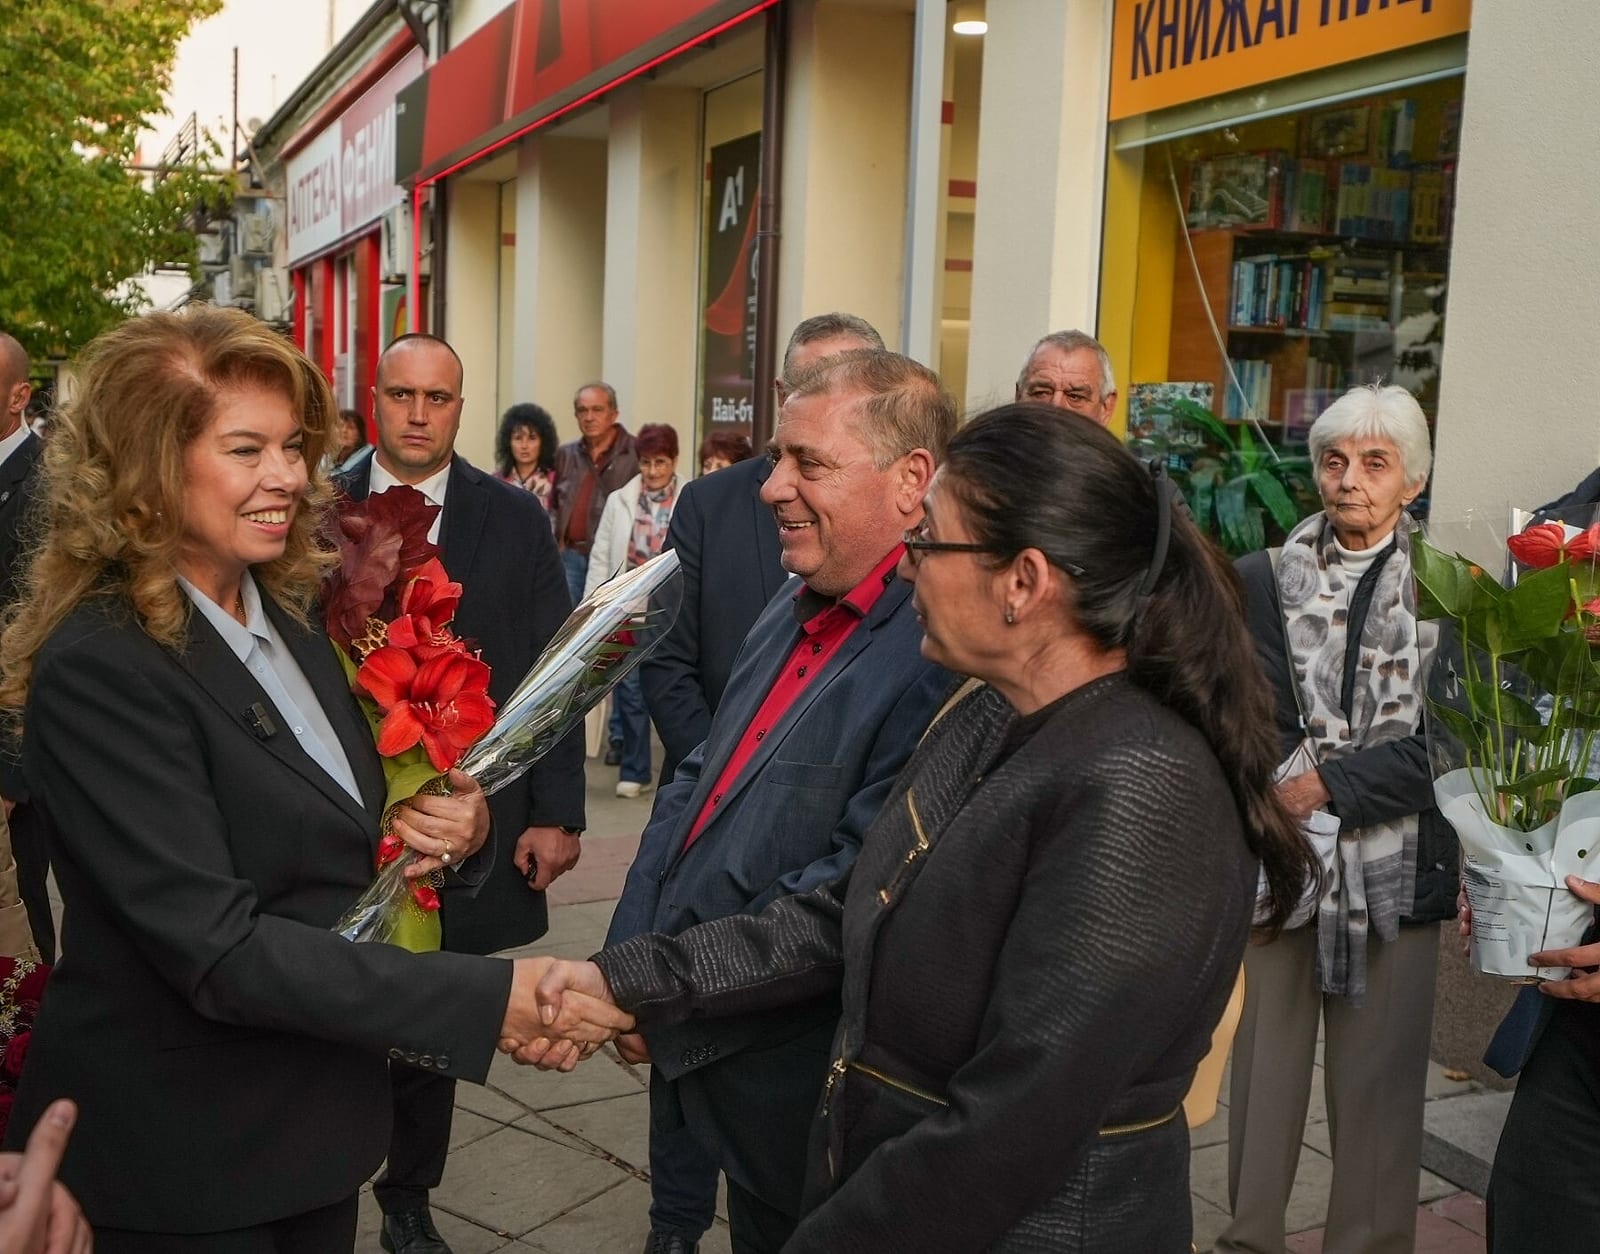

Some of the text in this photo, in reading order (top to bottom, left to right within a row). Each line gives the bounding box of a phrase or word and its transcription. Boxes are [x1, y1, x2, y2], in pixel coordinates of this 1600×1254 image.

[1130, 0, 1434, 80] КНИЖА
[290, 152, 338, 237] АПТЕКА
[718, 166, 744, 232] A1
